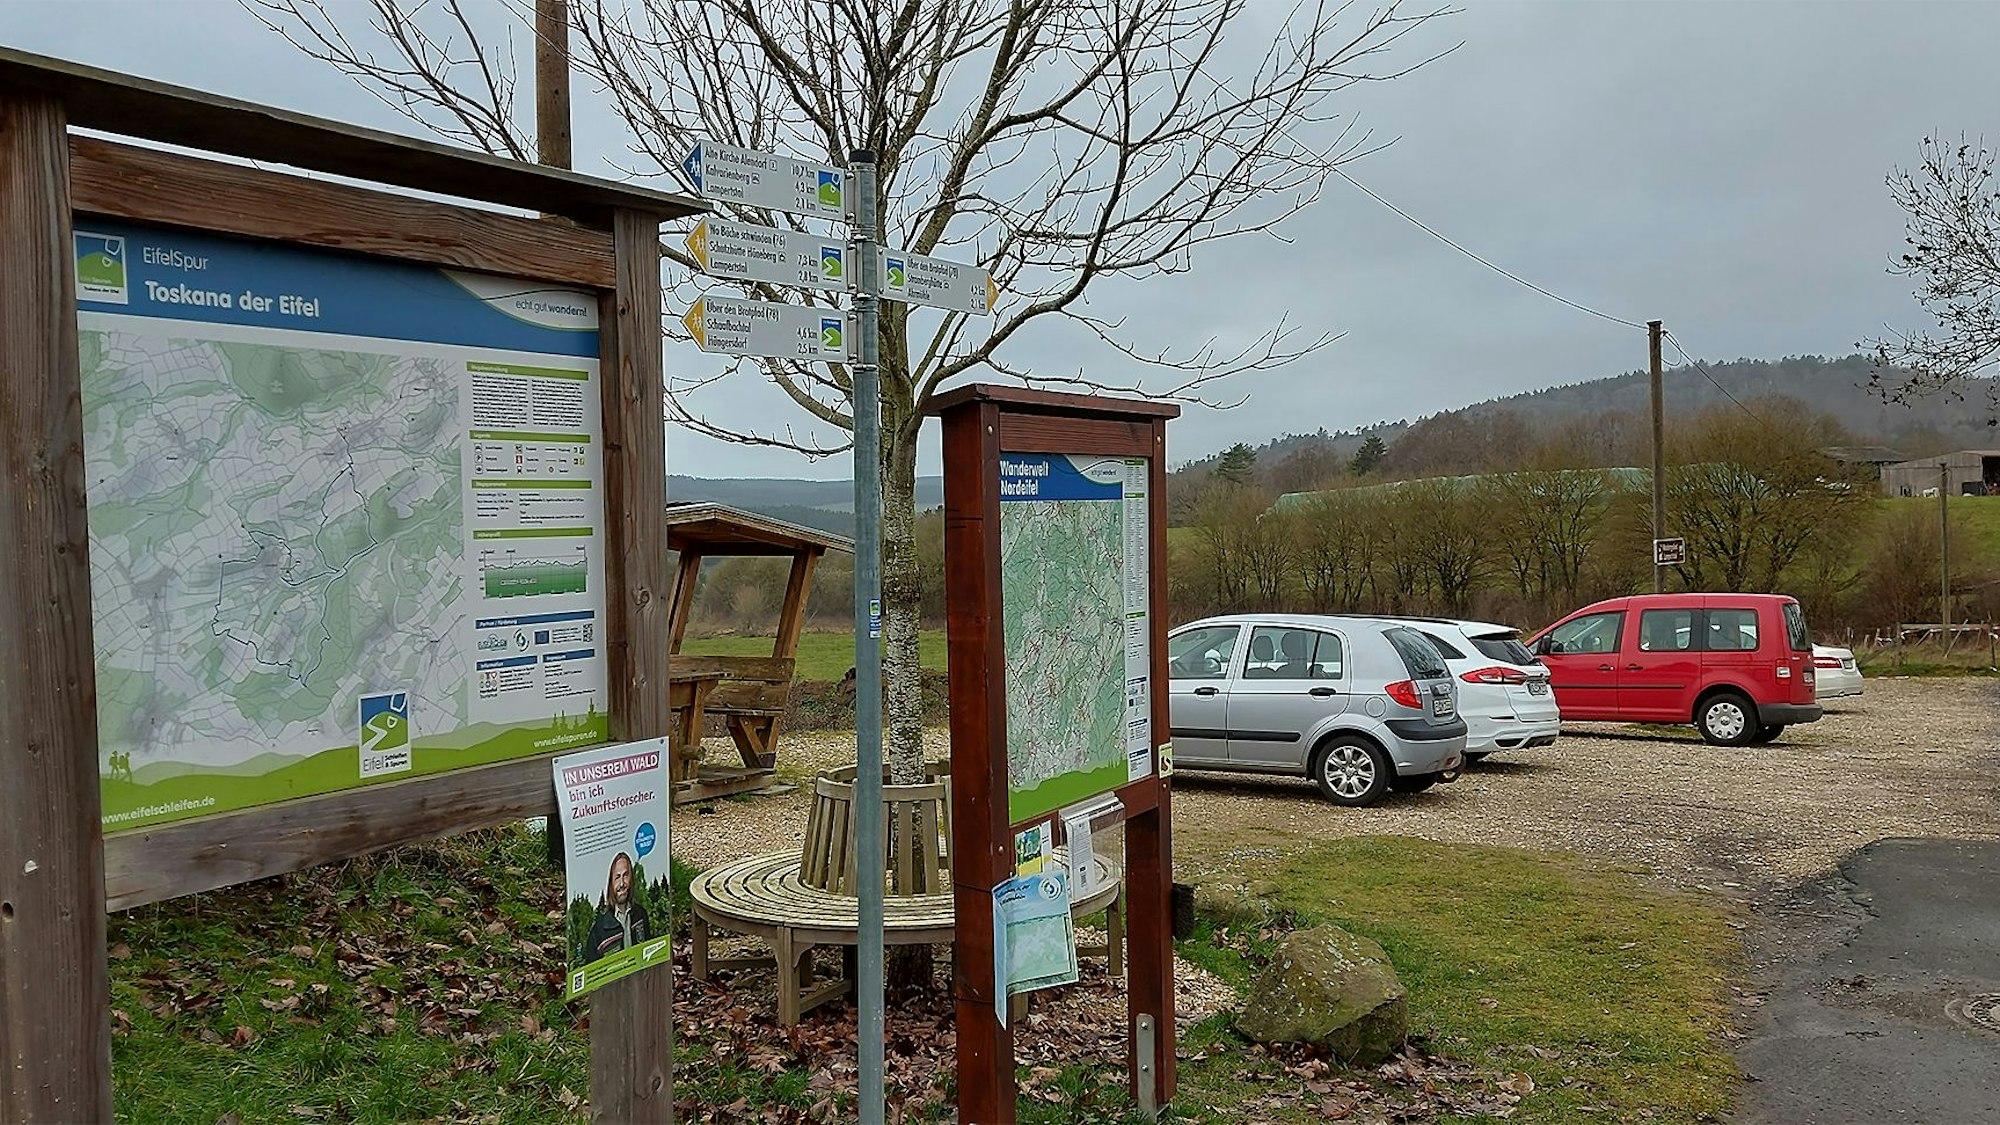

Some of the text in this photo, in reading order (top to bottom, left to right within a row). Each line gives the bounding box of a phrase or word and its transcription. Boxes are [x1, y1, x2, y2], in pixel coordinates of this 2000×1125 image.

[720, 149, 739, 163] Kirche
[741, 154, 767, 169] Alendorf
[705, 164, 750, 185] Kalvarienberg
[791, 164, 815, 179] 10,7 km
[706, 181, 744, 198] Lampertstal
[795, 182, 816, 195] 4,3 km
[795, 198, 816, 210] 2,1 km
[709, 223, 719, 235] Wo
[740, 229, 772, 244] schwinden
[143, 246, 208, 271] EifelSpur
[710, 258, 747, 273] Lampertstal
[808, 256, 818, 267] km
[809, 272, 819, 283] km
[145, 280, 320, 318] Toskana der Eifel
[706, 299, 722, 314] Über
[724, 303, 736, 315] den
[808, 327, 818, 339] km
[808, 344, 818, 355] km
[1000, 460, 1049, 476] Wanderwelt
[1001, 479, 1038, 496] Nordeifel
[533, 729, 598, 748] www.eifelspuren.de
[364, 755, 384, 772] Eifel
[565, 755, 658, 785] IN UNSEREM WALD
[569, 784, 604, 802] bin ich
[101, 796, 215, 824] www.eifelschleifen.de
[572, 791, 655, 819] Zukunftsforscher.
